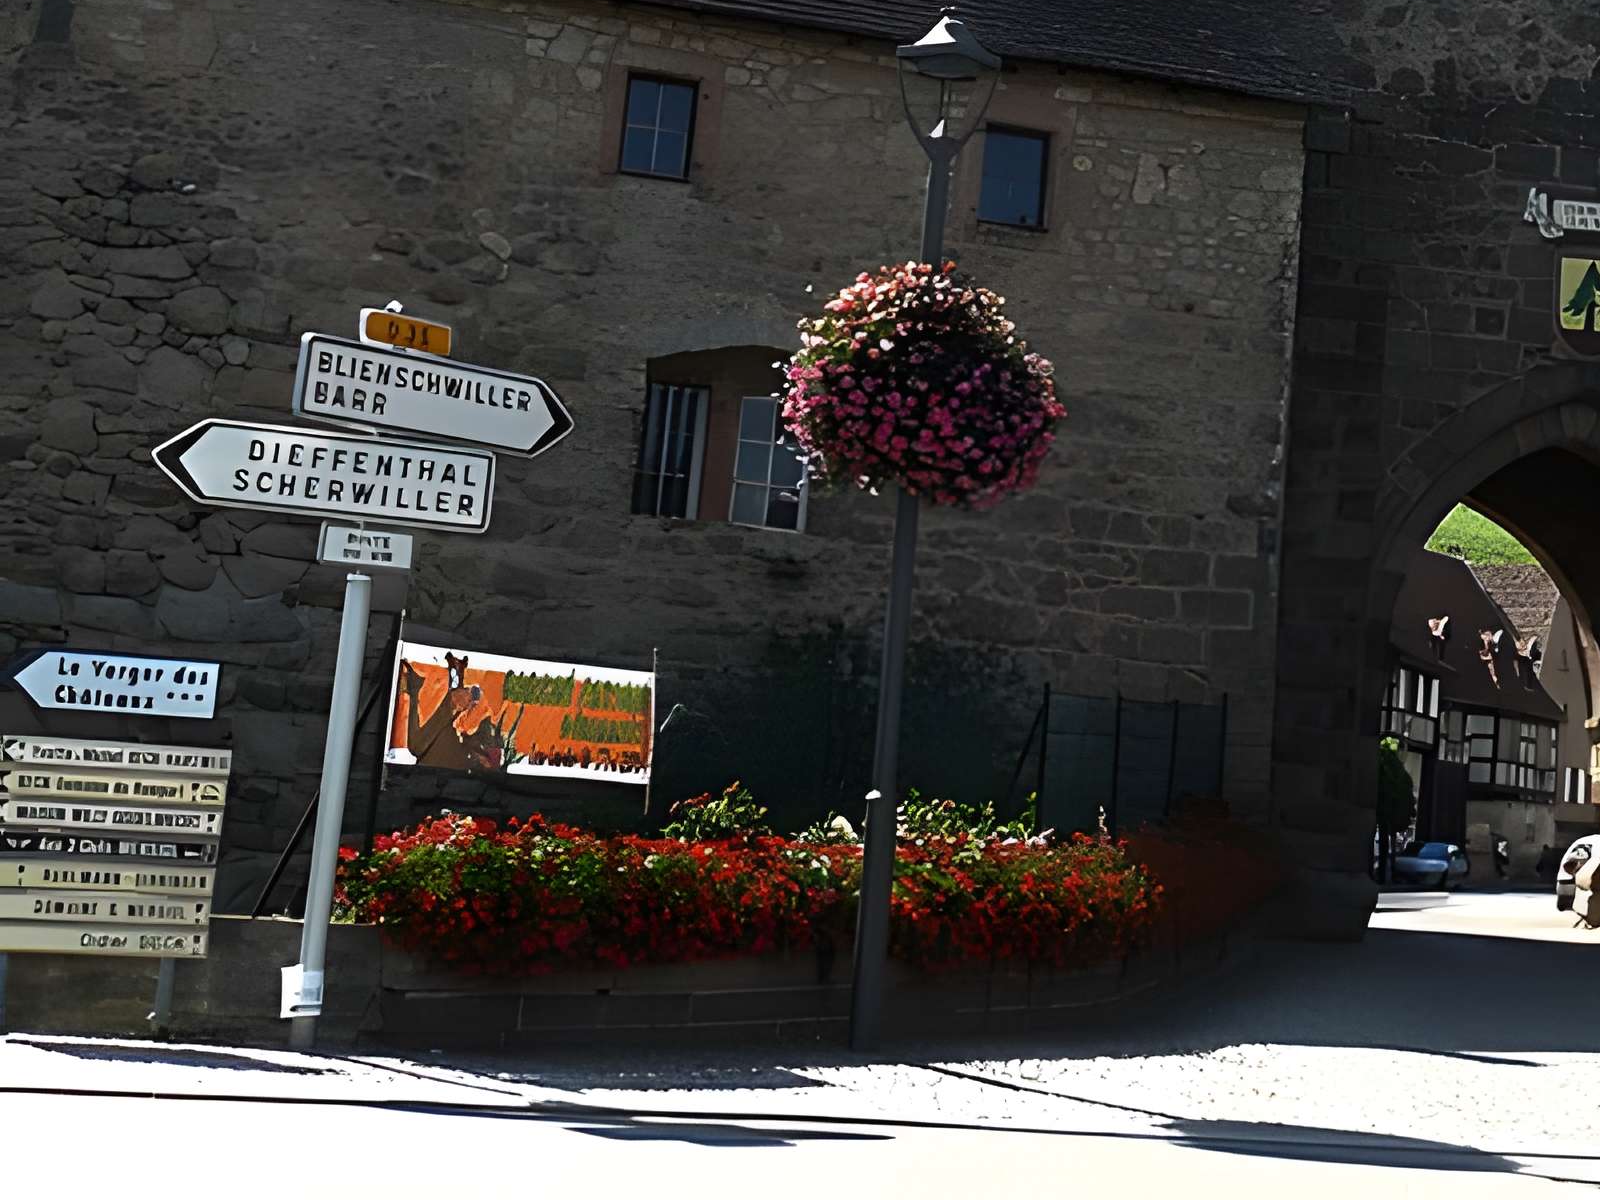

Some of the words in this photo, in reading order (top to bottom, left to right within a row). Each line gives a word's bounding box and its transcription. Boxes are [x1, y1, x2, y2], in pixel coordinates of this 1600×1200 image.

[314, 381, 388, 415] BARR
[317, 351, 532, 412] BLIENSCHWILLER
[248, 439, 477, 487] DIEFFENTHAL
[232, 468, 474, 517] SCHERWILLER
